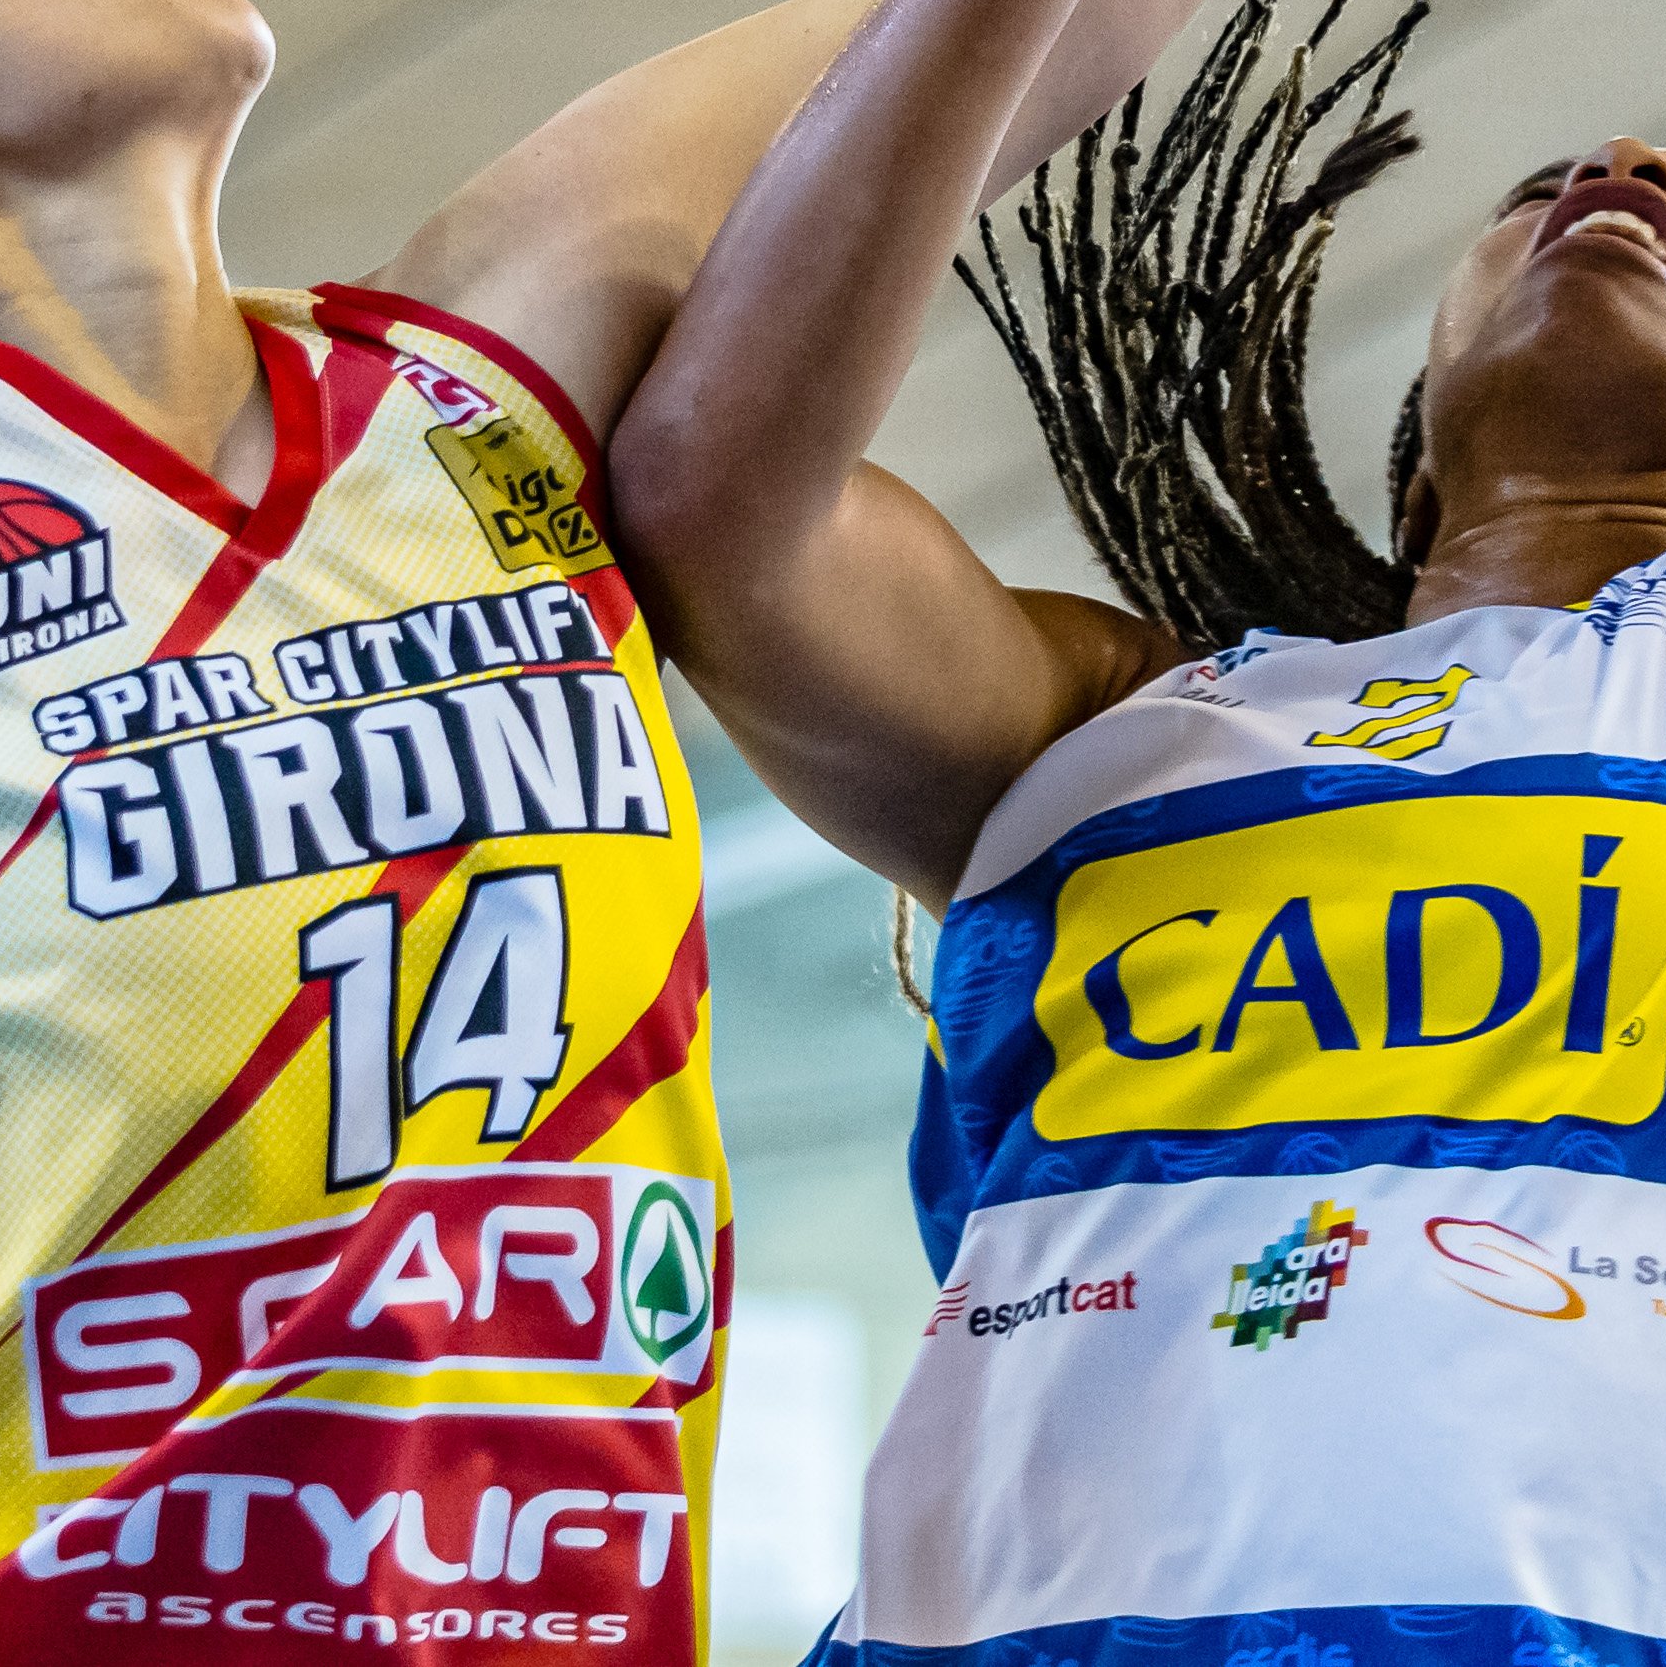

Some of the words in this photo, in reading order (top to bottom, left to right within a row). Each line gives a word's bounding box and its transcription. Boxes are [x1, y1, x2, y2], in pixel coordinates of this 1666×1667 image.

[34, 654, 275, 755] SPAR
[277, 584, 615, 704] CITYLIFT
[60, 675, 671, 919] GIRONA
[1084, 833, 1624, 1061] CADÍ
[299, 865, 573, 1194] 14
[968, 1271, 1139, 1340] esportcat
[1286, 1236, 1351, 1271] ara
[1568, 1245, 1618, 1279] La
[16, 1471, 689, 1589] CITYLIFT
